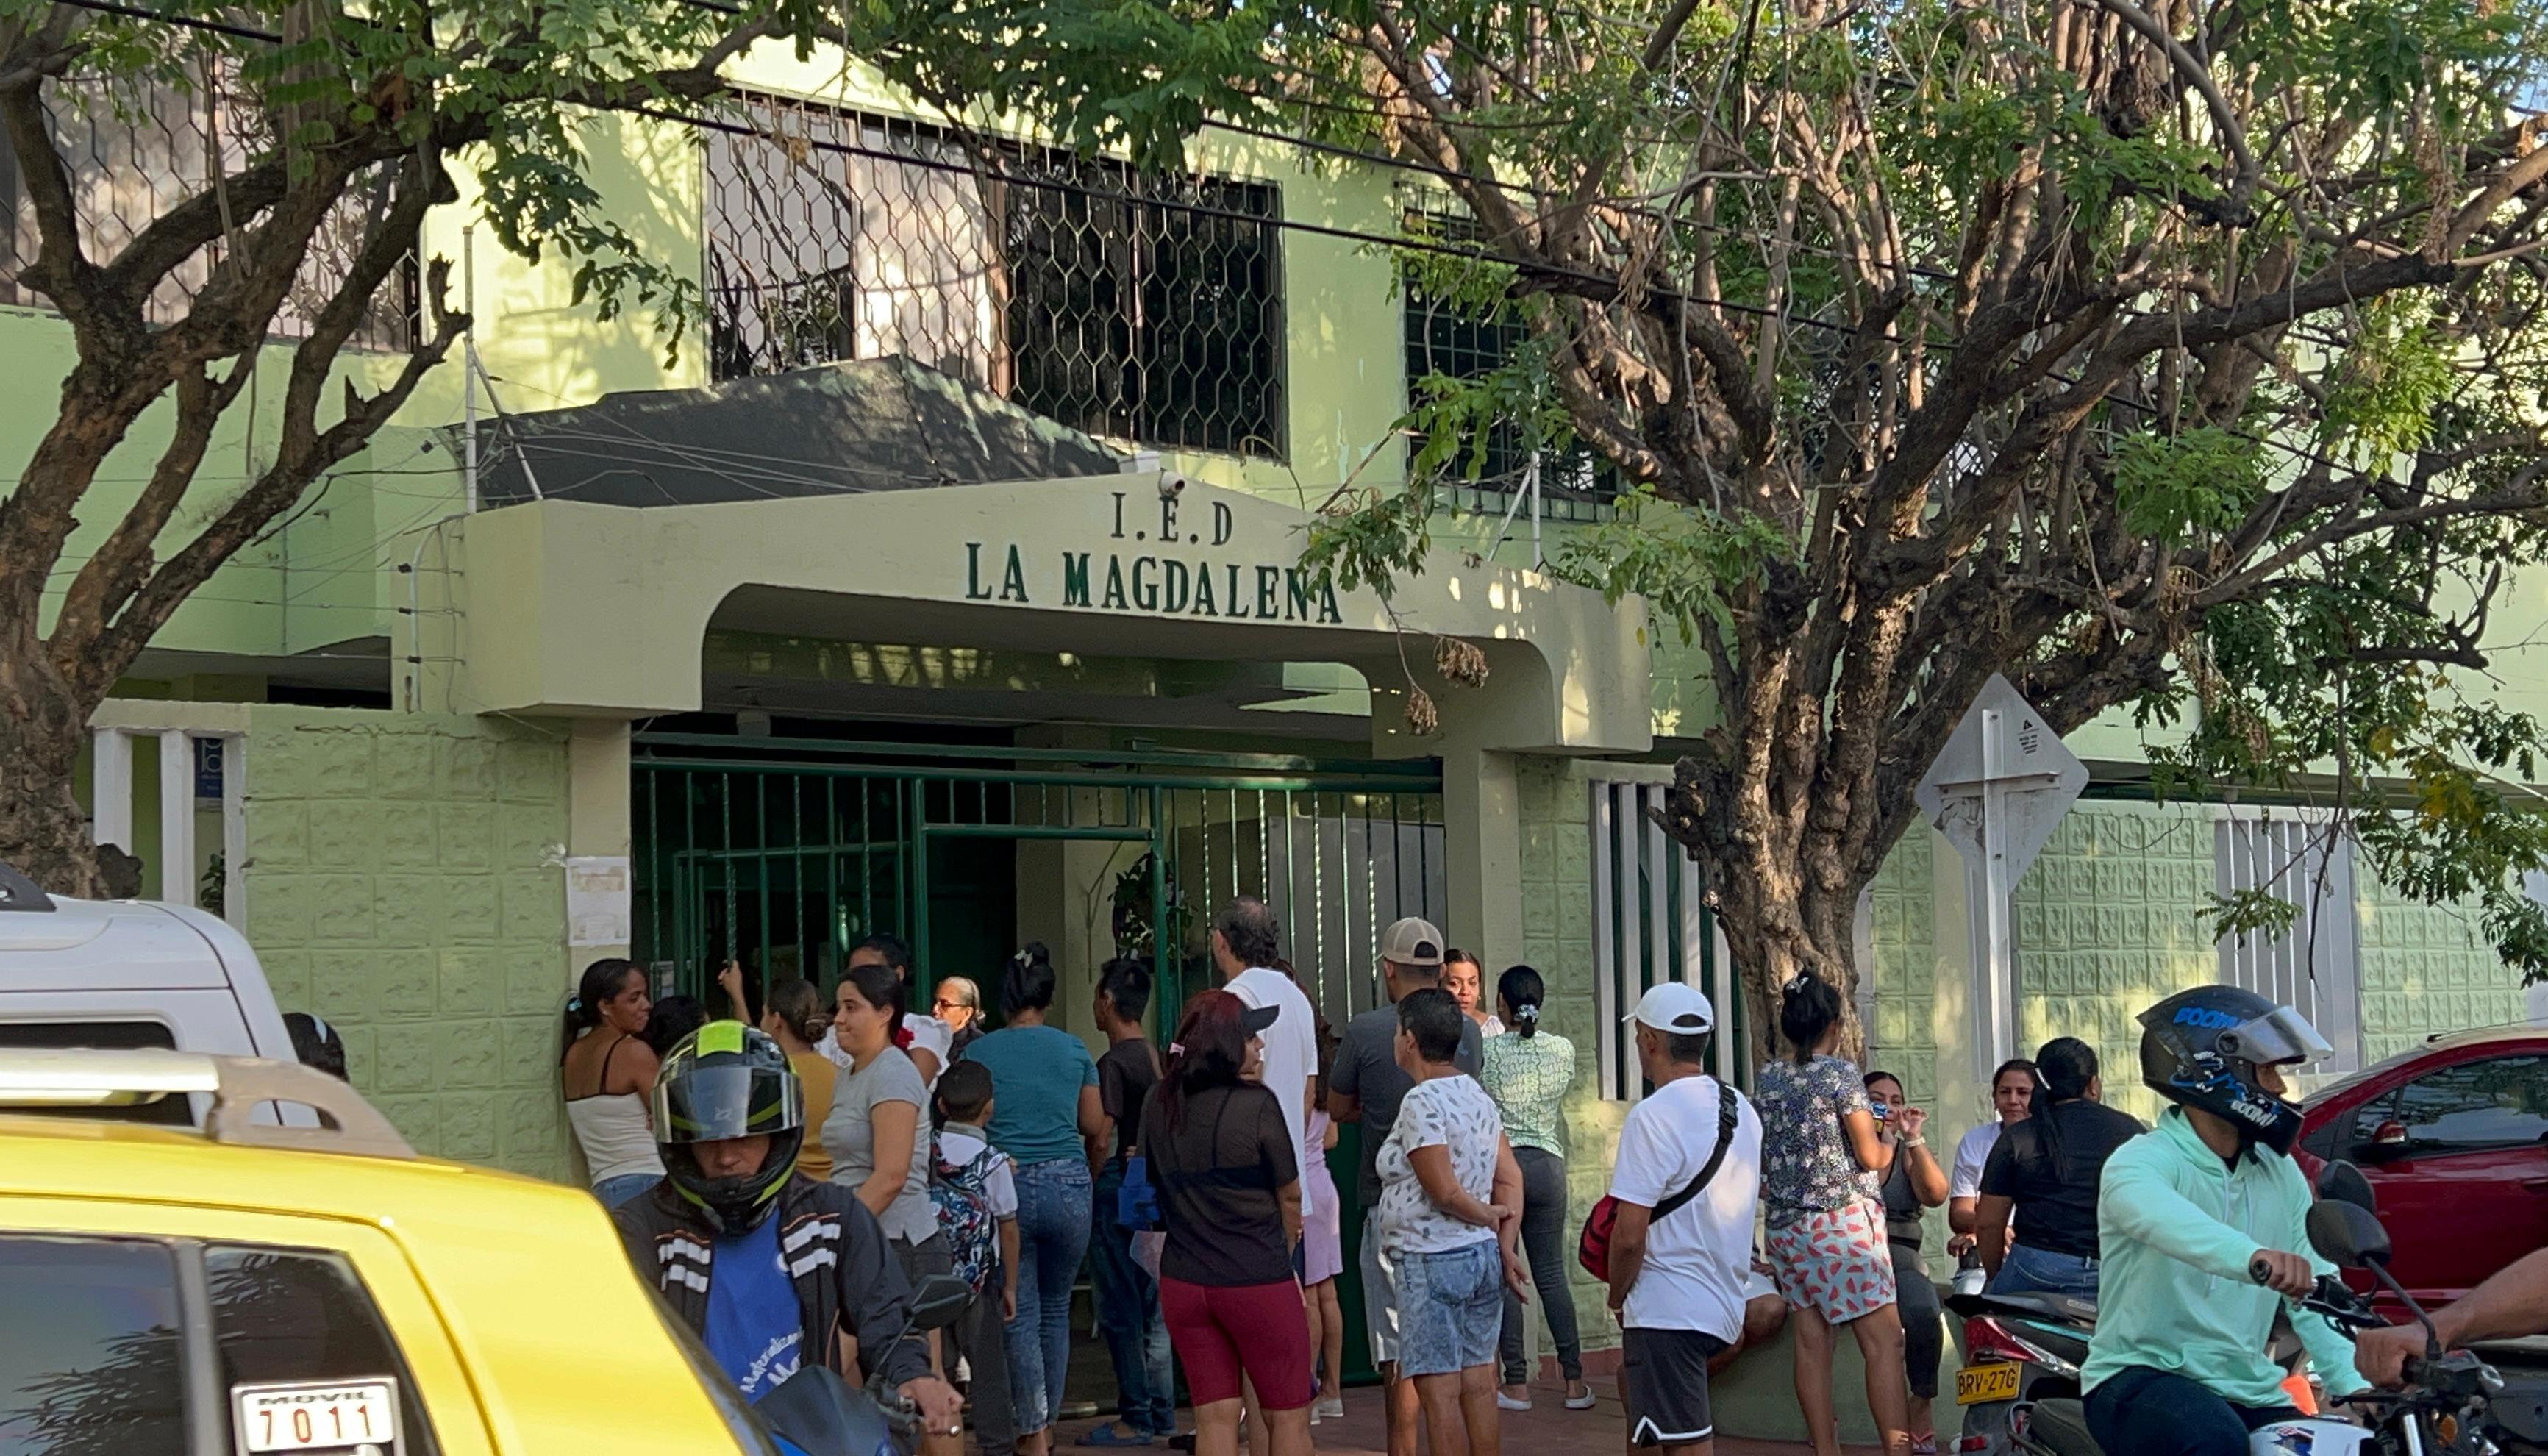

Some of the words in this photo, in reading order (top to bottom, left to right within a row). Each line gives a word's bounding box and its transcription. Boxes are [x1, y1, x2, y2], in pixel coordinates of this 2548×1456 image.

[964, 542, 1029, 602] LA
[1062, 551, 1343, 624] MAGDALENA
[259, 1405, 371, 1445] 7011
